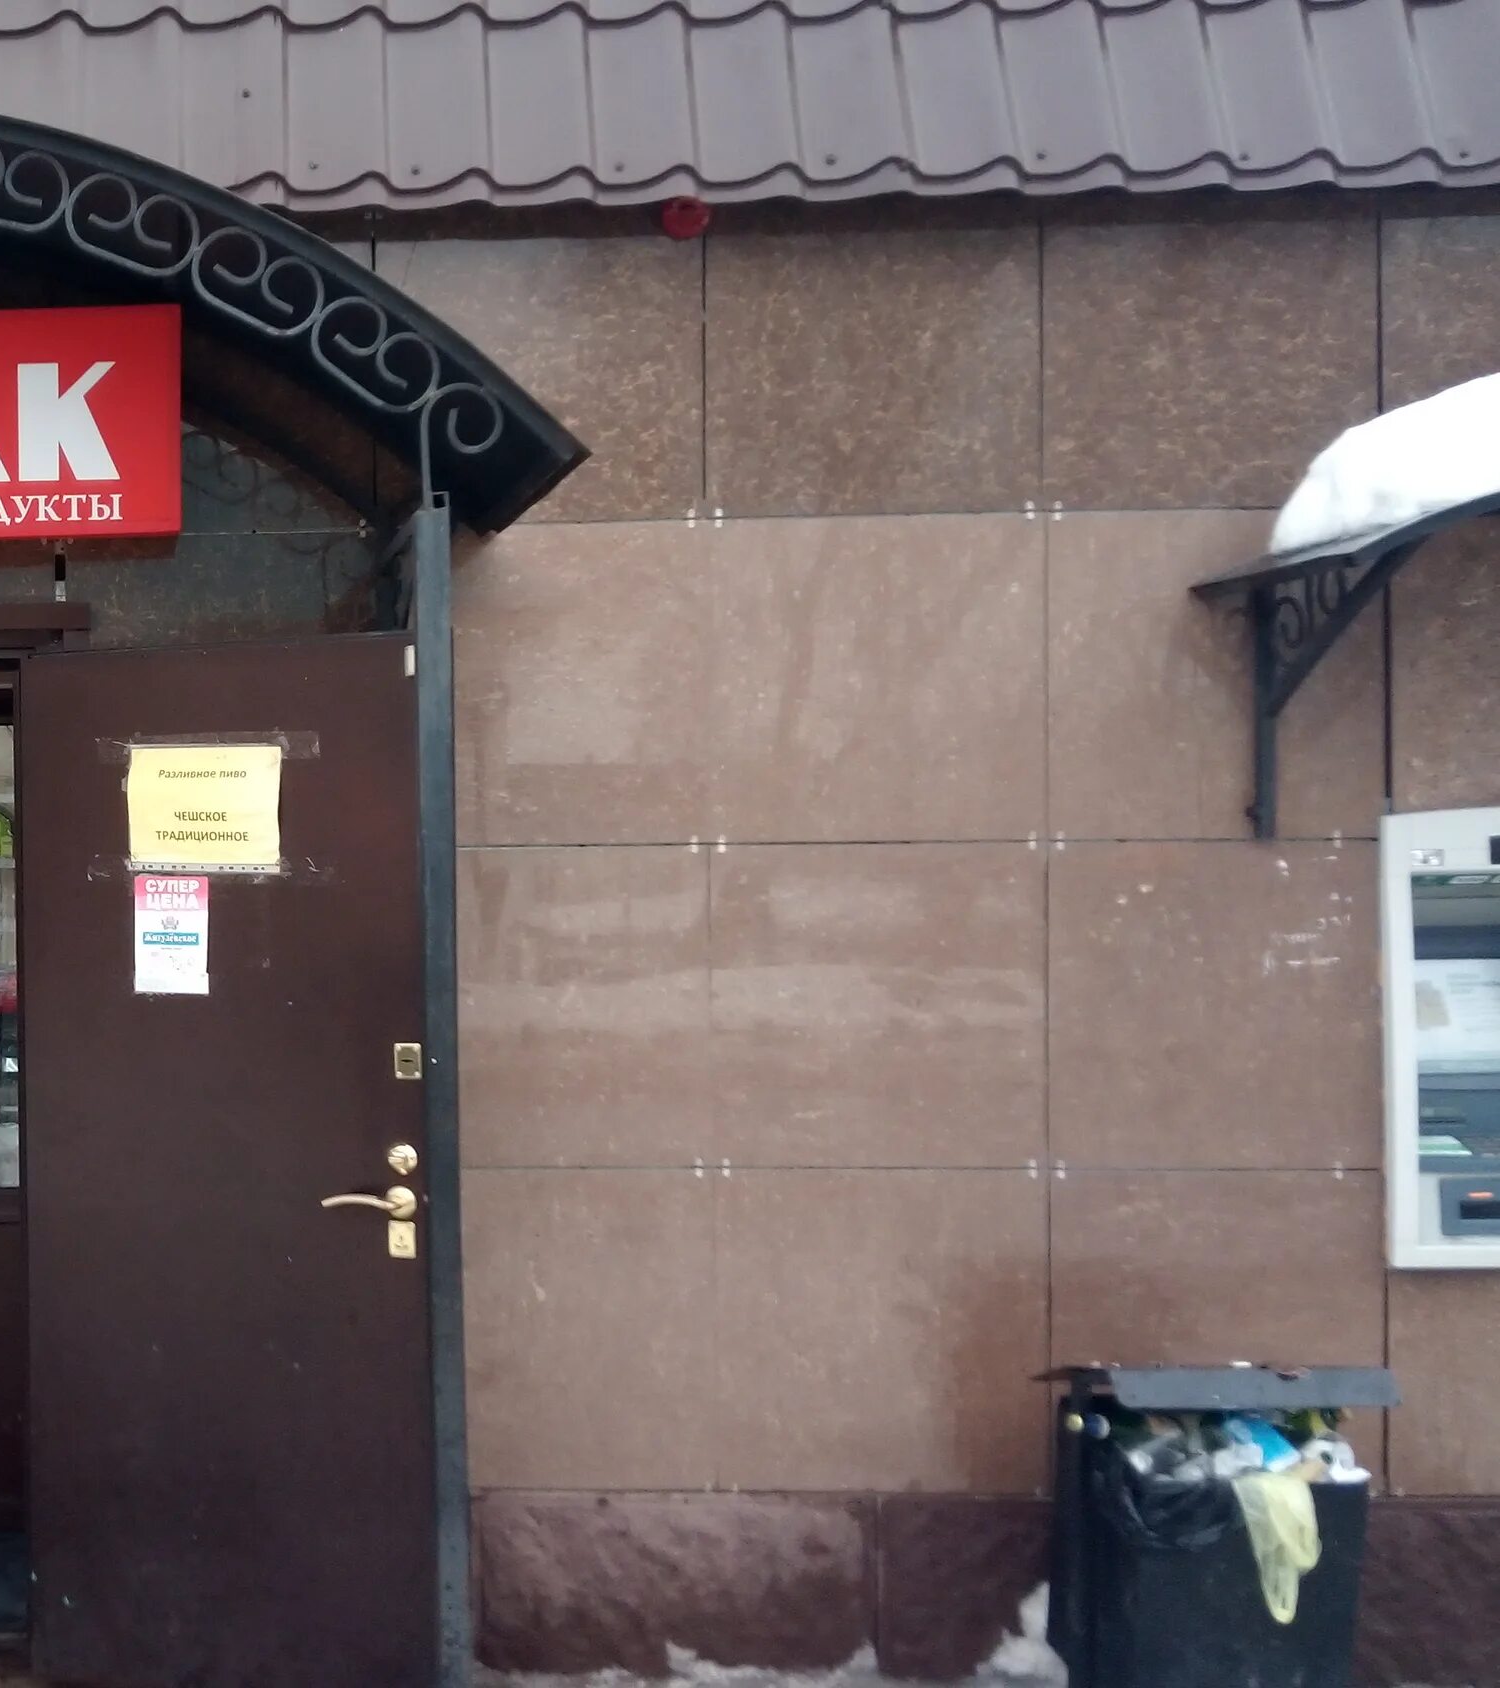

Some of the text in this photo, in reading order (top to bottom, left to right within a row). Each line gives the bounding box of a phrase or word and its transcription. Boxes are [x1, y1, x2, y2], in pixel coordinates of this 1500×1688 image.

[158, 769, 247, 779] Разливное пиво
[174, 811, 227, 822] ЧЕШСКОЕ
[155, 830, 250, 843] ТРАДИЦИОННОЕ
[145, 879, 200, 894] СУПЕР
[145, 893, 200, 909] ЦЕНА
